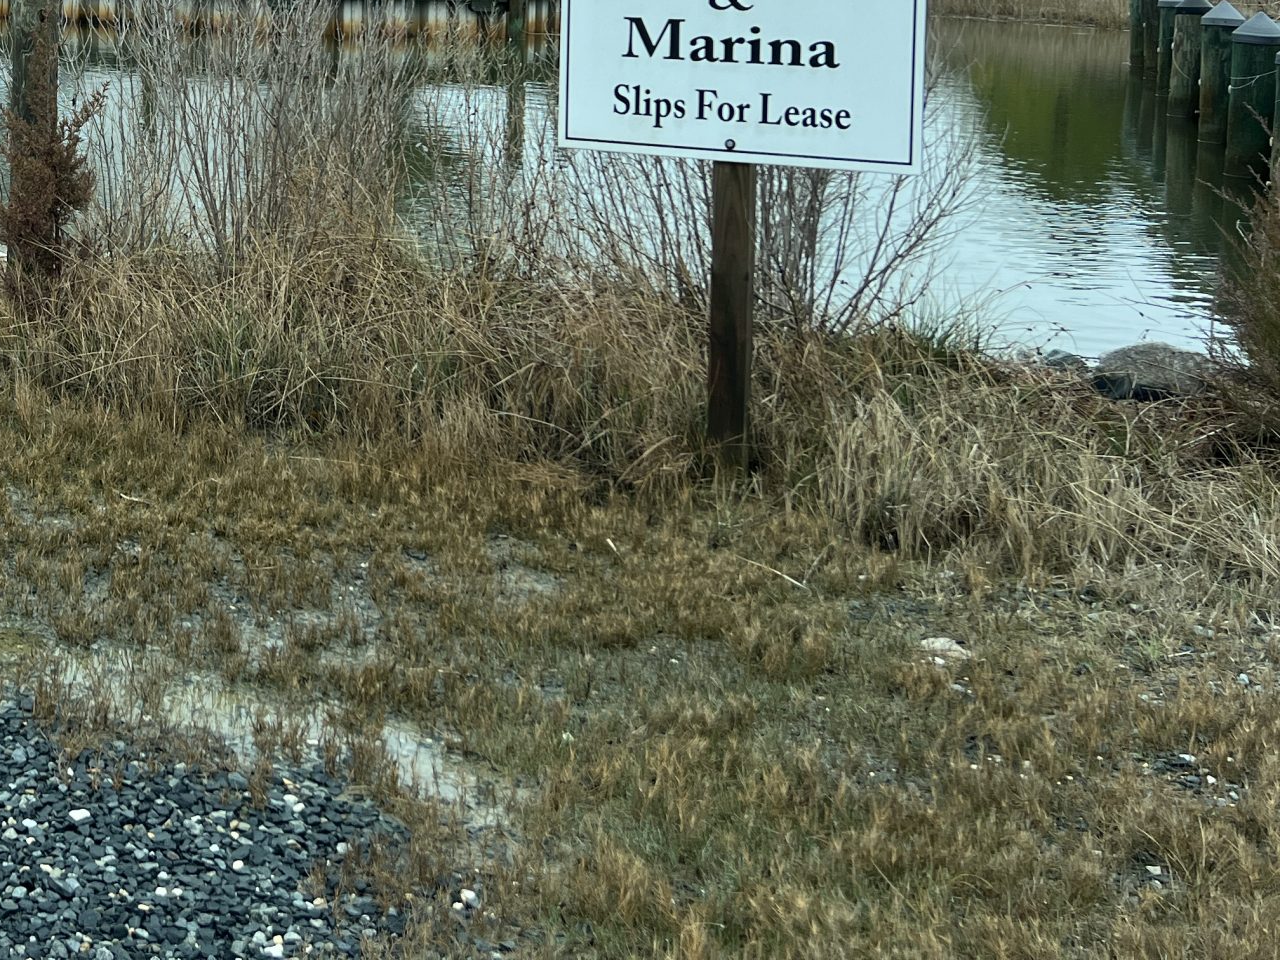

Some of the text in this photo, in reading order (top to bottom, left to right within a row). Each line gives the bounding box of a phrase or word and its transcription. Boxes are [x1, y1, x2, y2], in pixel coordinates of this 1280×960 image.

[622, 16, 841, 69] Marina
[613, 83, 851, 131] Slips For Lease
